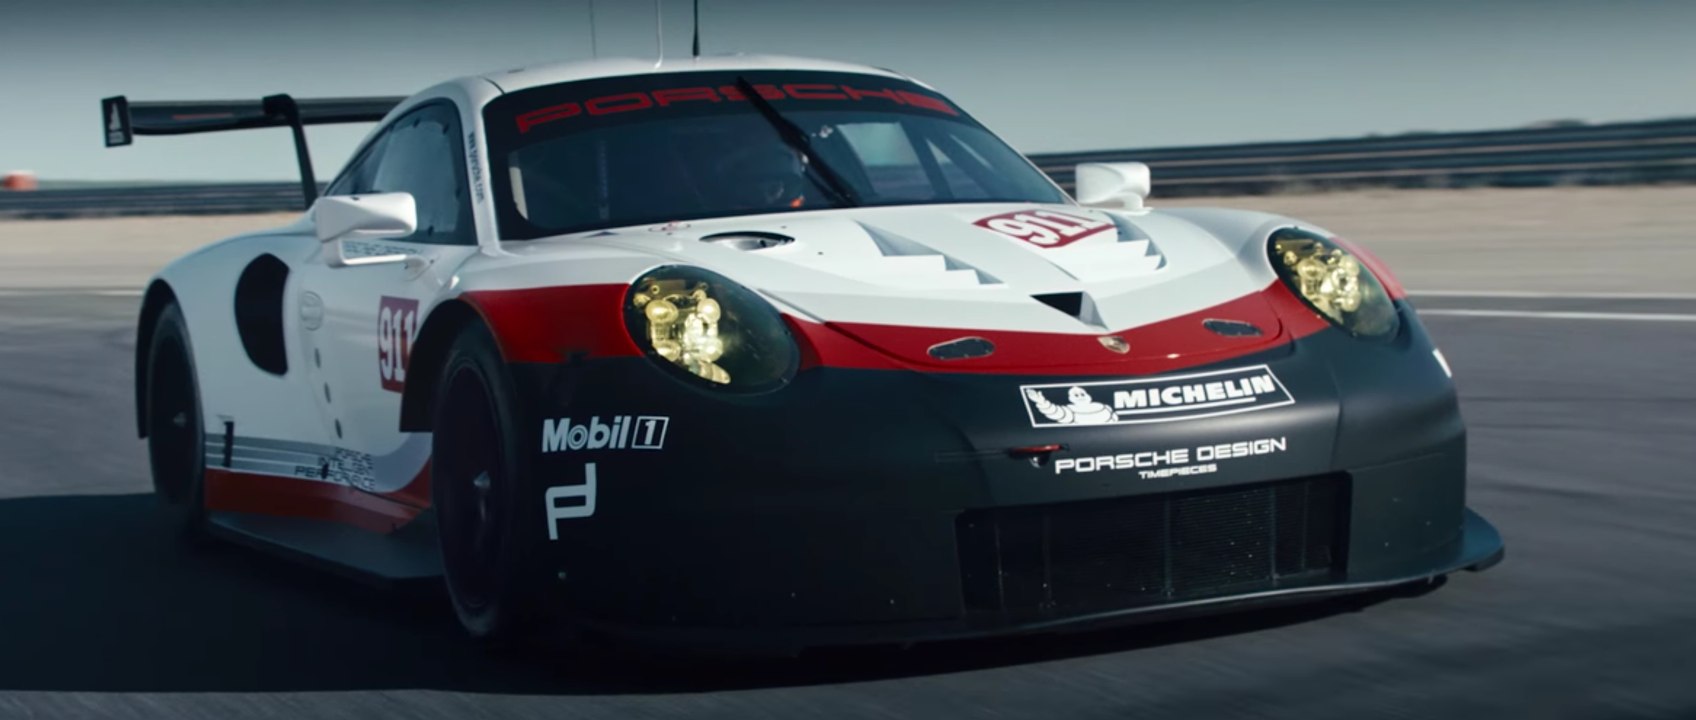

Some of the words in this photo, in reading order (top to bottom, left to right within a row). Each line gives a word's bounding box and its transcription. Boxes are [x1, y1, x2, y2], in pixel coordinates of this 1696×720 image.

[516, 84, 957, 133] PORSCHE
[987, 210, 1109, 246] 911
[379, 305, 415, 382] 911
[1113, 373, 1276, 409] MICHELIN
[542, 415, 632, 453] Mobil
[1055, 448, 1190, 475] PORSCHE
[1196, 436, 1287, 463] DESIGN
[1138, 463, 1218, 480] TIMEPIECES
